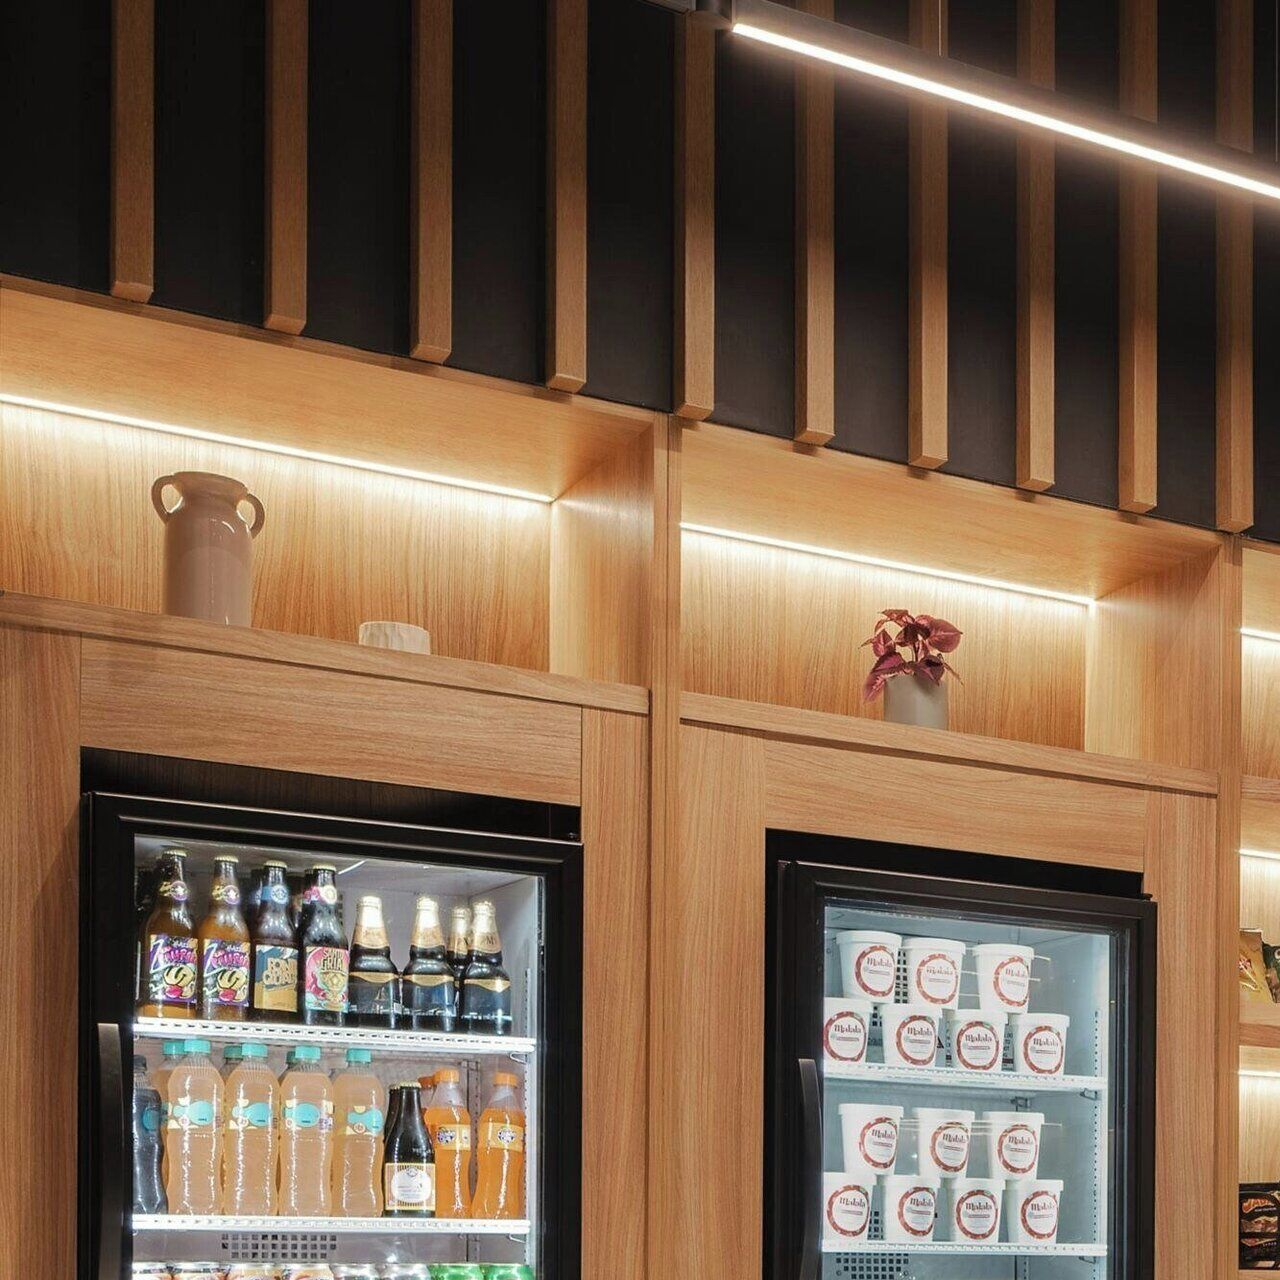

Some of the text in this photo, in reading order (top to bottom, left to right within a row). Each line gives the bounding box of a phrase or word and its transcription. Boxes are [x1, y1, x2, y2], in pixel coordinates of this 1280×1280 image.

[834, 1024, 862, 1034] Malala
[907, 1026, 933, 1036] Malala
[965, 1033, 993, 1043] Malala
[1033, 1037, 1059, 1047] Malala
[871, 1129, 896, 1141] Malala
[942, 1132, 966, 1144] Malala
[840, 1196, 866, 1208] Malala
[910, 1197, 934, 1208] Malala
[965, 1202, 992, 1212] Malala
